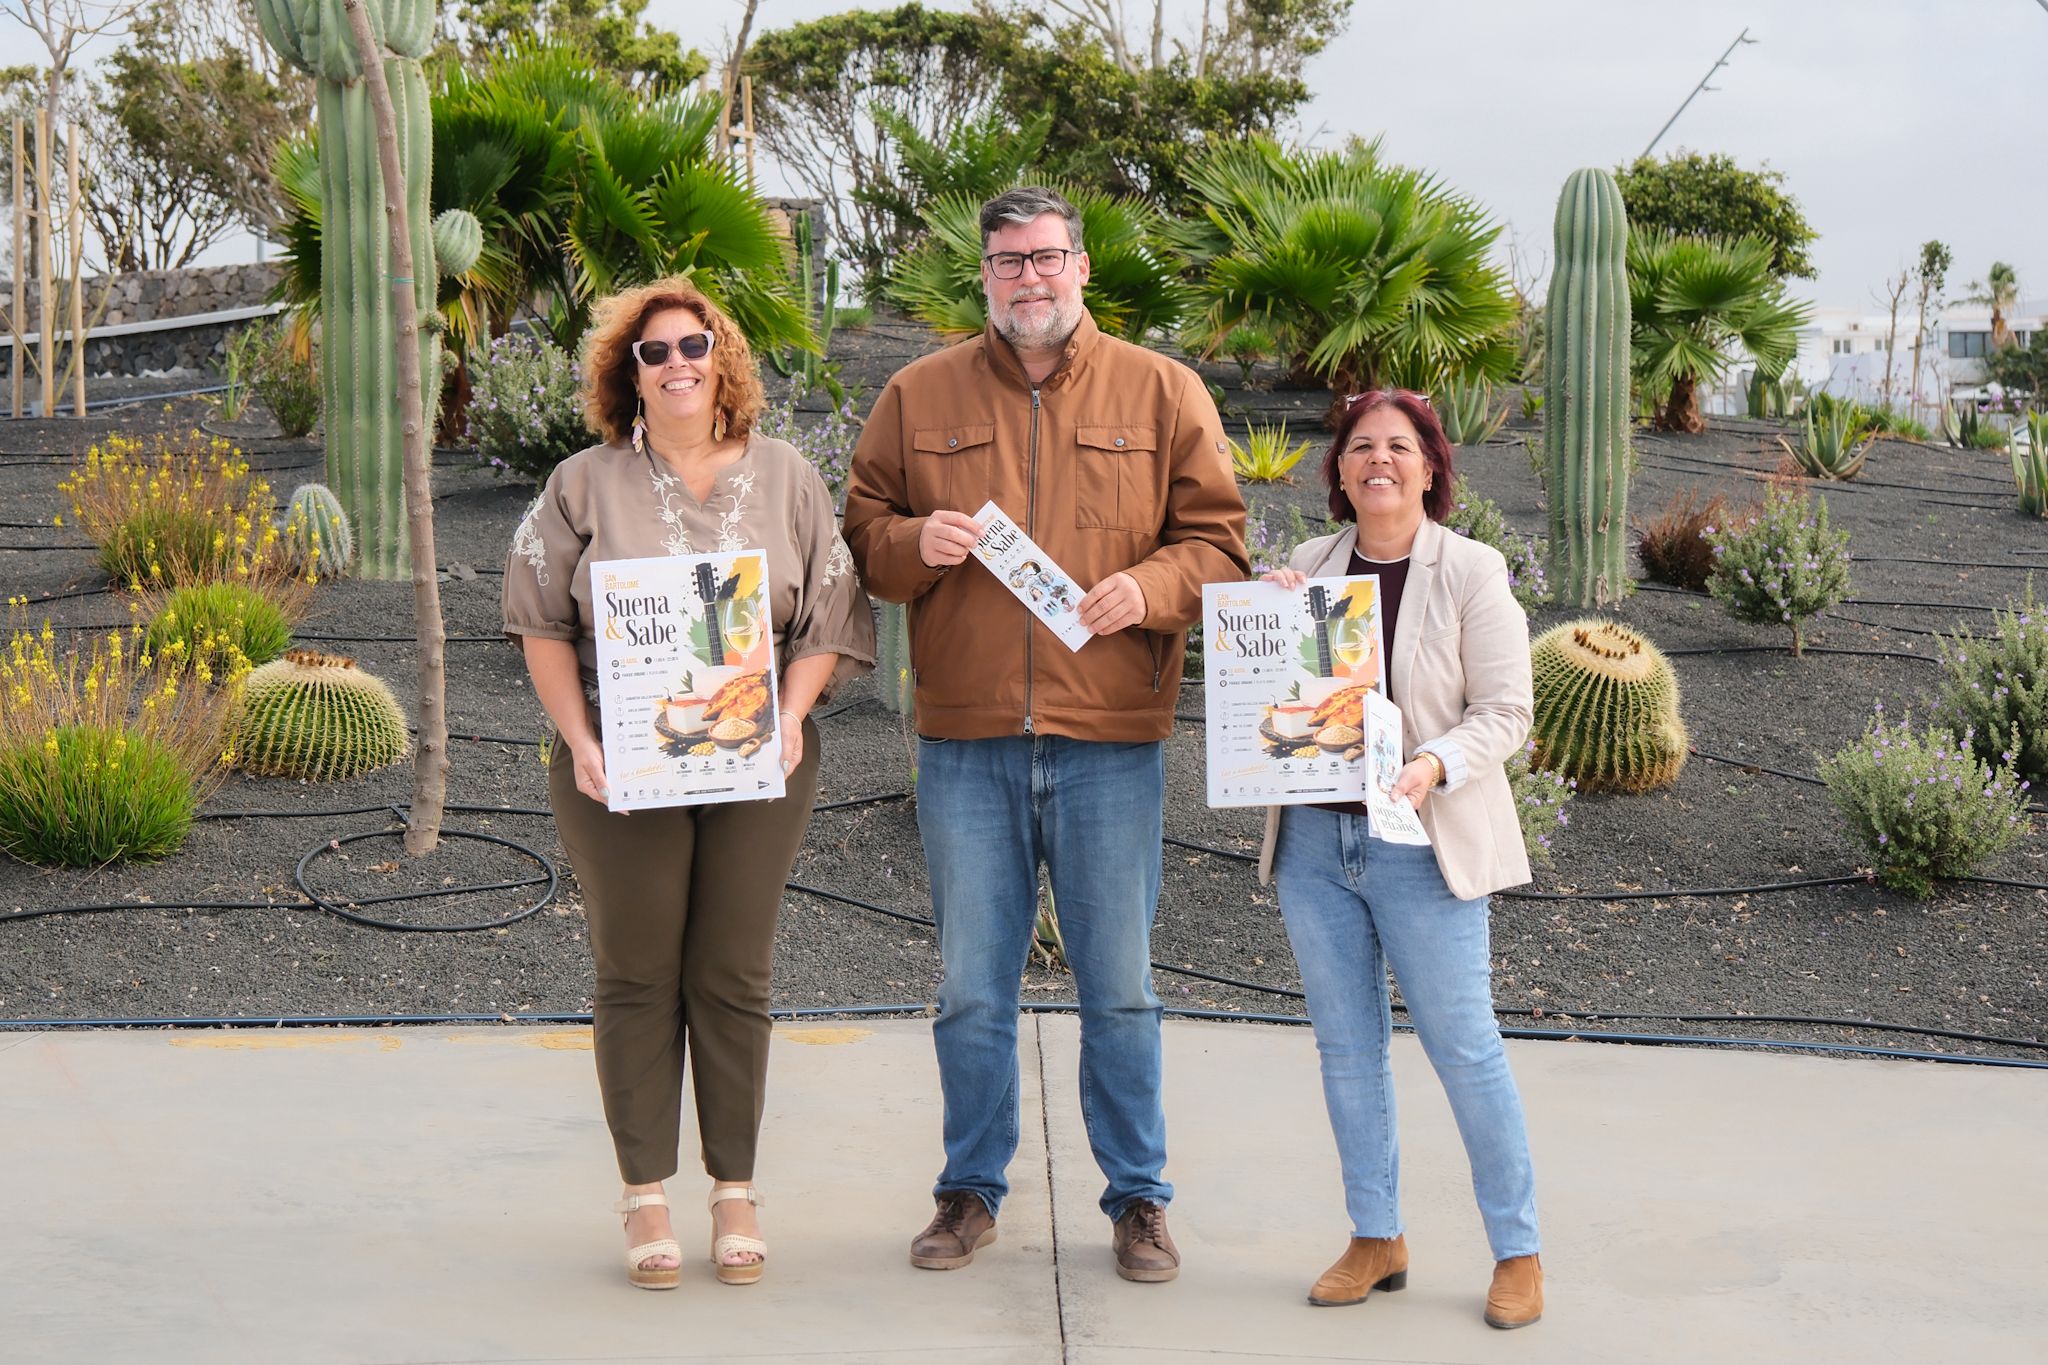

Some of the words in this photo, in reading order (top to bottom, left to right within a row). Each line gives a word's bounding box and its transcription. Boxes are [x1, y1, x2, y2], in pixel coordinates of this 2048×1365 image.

[991, 530, 1020, 556] Sabe
[606, 592, 671, 617] Suena
[605, 616, 623, 640] &
[626, 618, 677, 646] Sabe
[1217, 609, 1281, 631] Suena
[1215, 631, 1232, 651] &
[1236, 633, 1287, 658] Sabe
